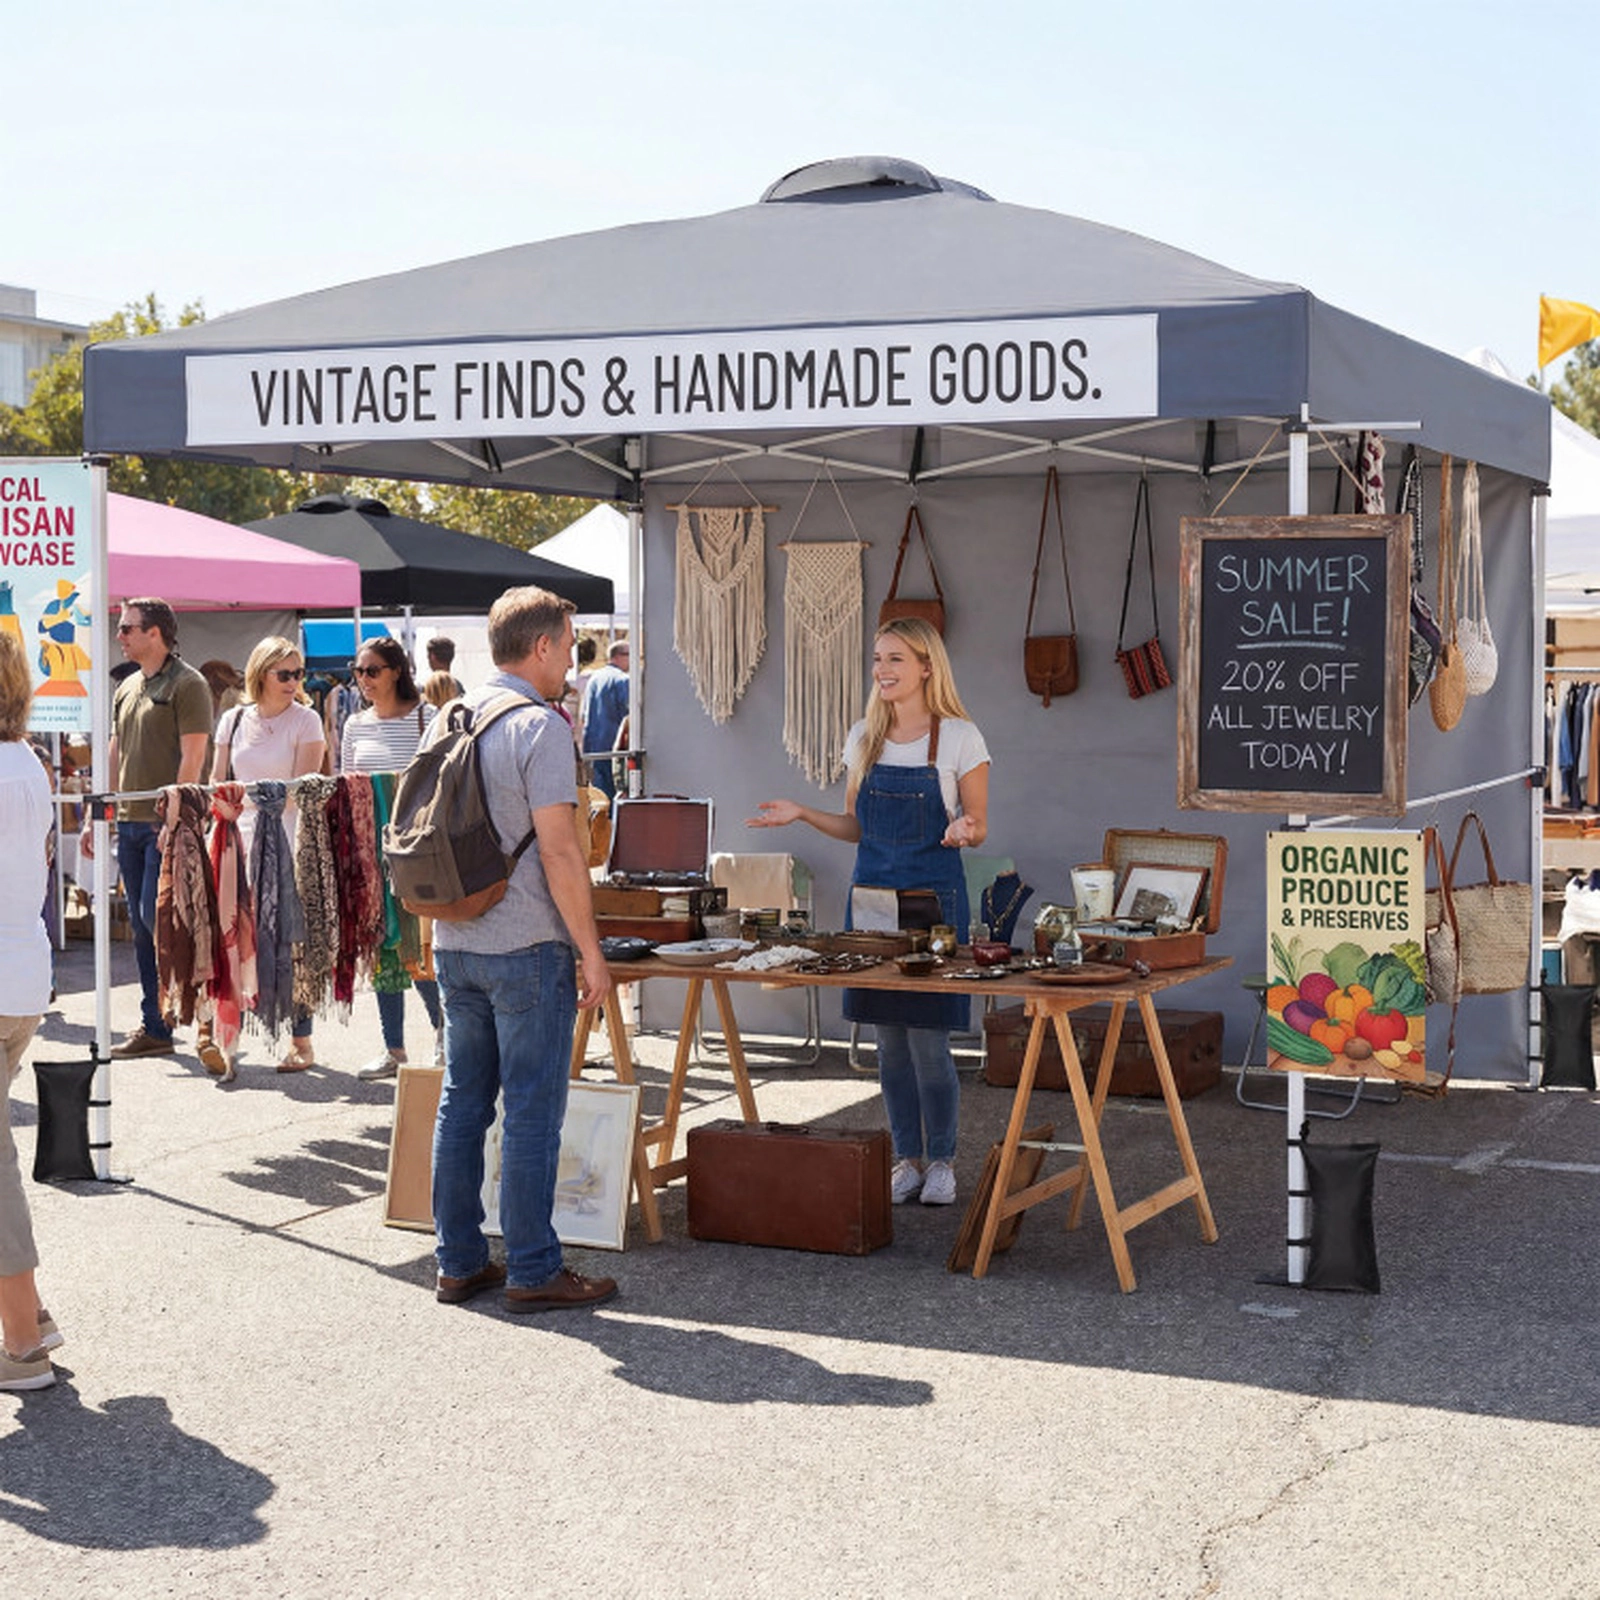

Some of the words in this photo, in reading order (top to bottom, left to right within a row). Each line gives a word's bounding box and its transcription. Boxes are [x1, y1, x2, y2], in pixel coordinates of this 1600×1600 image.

[251, 364, 436, 427] VINTAGE
[455, 358, 586, 420] FINDS
[602, 356, 636, 417] &
[654, 346, 912, 414] HANDMADE
[929, 338, 1102, 405] GOODS.
[0, 477, 47, 502] CAL
[3, 506, 74, 536] ISAN
[1216, 554, 1371, 593] SUMMER
[1240, 597, 1350, 637] SALE!
[1221, 660, 1286, 693] 20%
[1299, 663, 1360, 694] OFF
[1207, 704, 1253, 730] ALL
[1261, 705, 1379, 736] JEWELRY
[1240, 739, 1349, 775] TODAY!
[1281, 845, 1409, 876] ORGANIC
[1281, 877, 1409, 907] PRODUCE
[1281, 908, 1295, 927] &
[1300, 909, 1409, 931] PRESERVES
